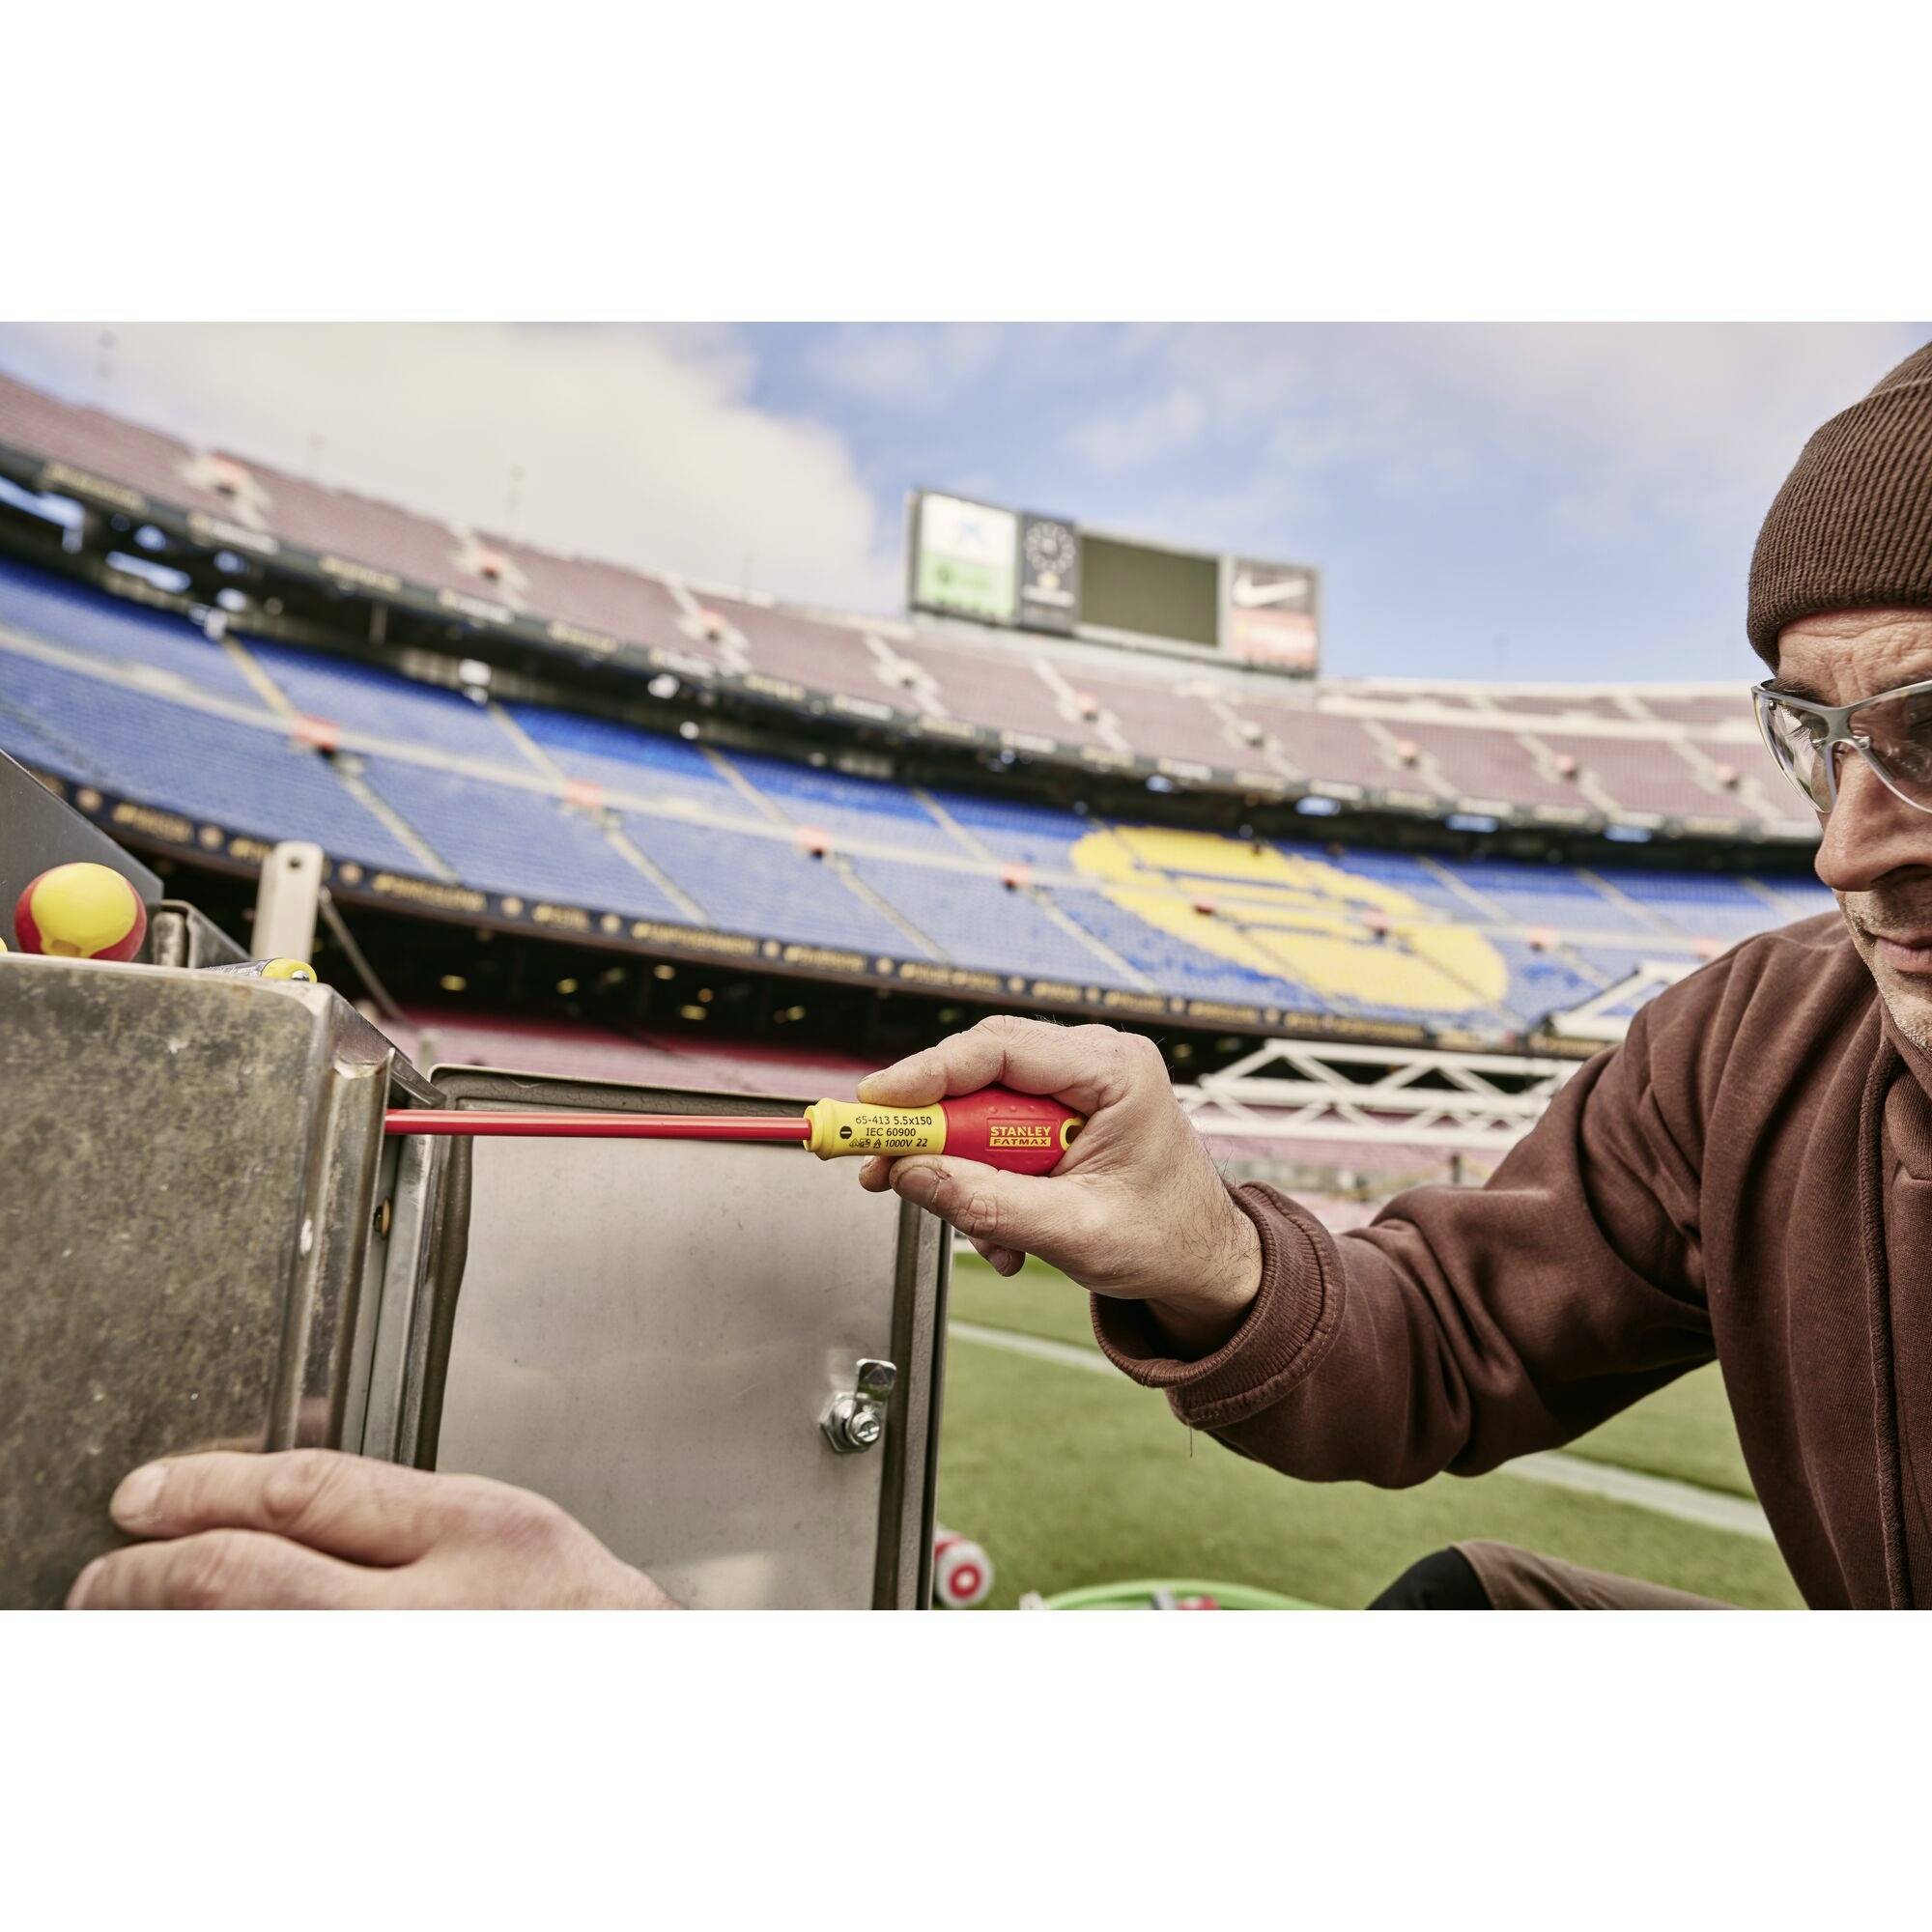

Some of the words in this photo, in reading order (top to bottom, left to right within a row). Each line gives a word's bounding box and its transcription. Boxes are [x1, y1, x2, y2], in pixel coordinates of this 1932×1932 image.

[855, 1115, 891, 1125] 65-413
[894, 1116, 933, 1125] 5.5x150
[866, 1127, 884, 1137] IEC
[886, 1127, 917, 1137] 60900
[989, 1125, 1052, 1137] STANLEY
[885, 1139, 913, 1148] 1000V
[916, 1138, 928, 1148] 22
